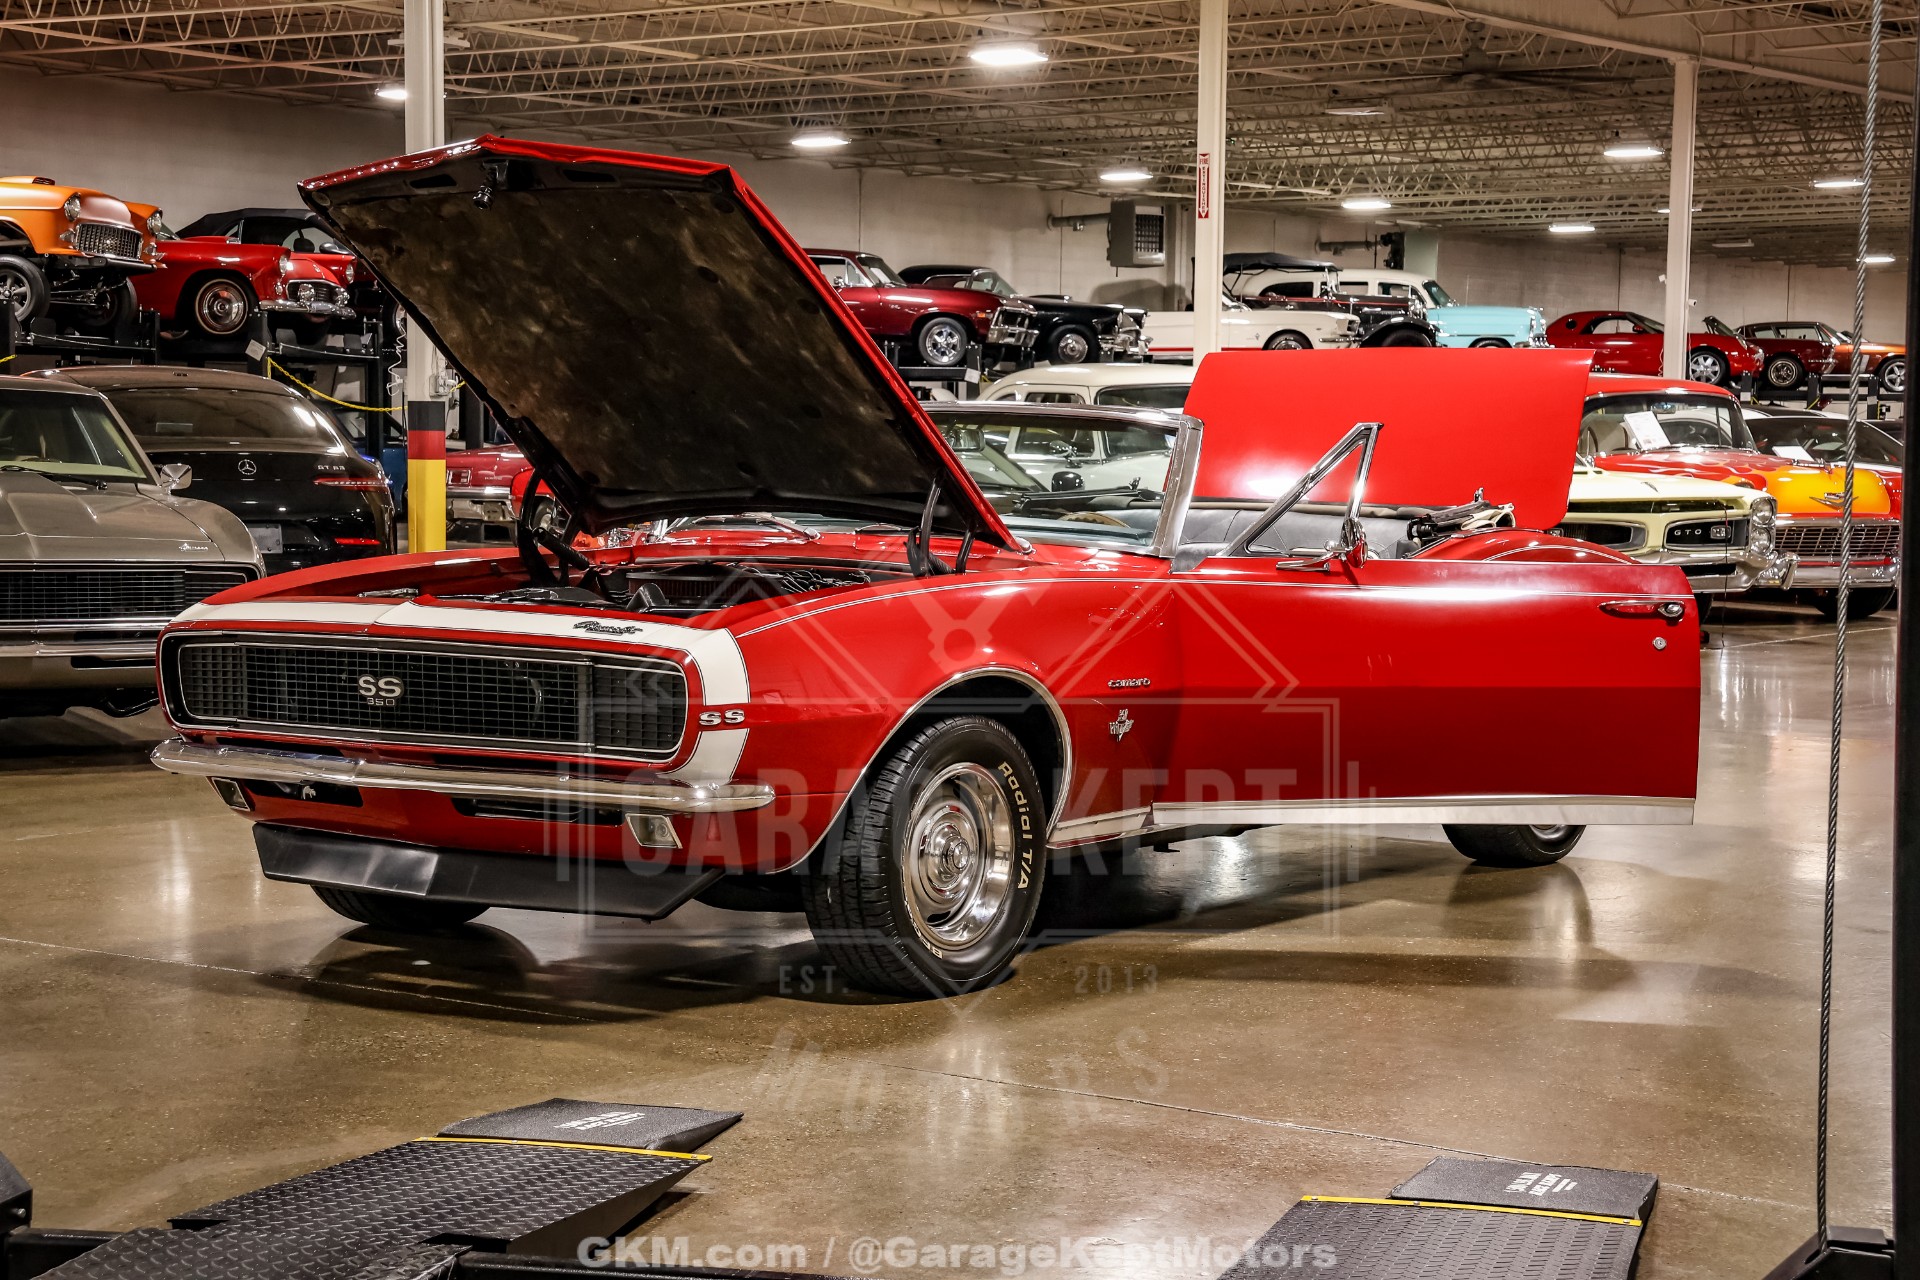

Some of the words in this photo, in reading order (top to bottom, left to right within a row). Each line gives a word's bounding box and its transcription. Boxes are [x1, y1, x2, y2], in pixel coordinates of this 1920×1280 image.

[1199, 157, 1209, 165] FIRE
[358, 675, 402, 697] SS
[367, 697, 395, 706] 350
[698, 708, 746, 726] SS
[998, 761, 1033, 840] Radial
[1017, 848, 1033, 889] T/A
